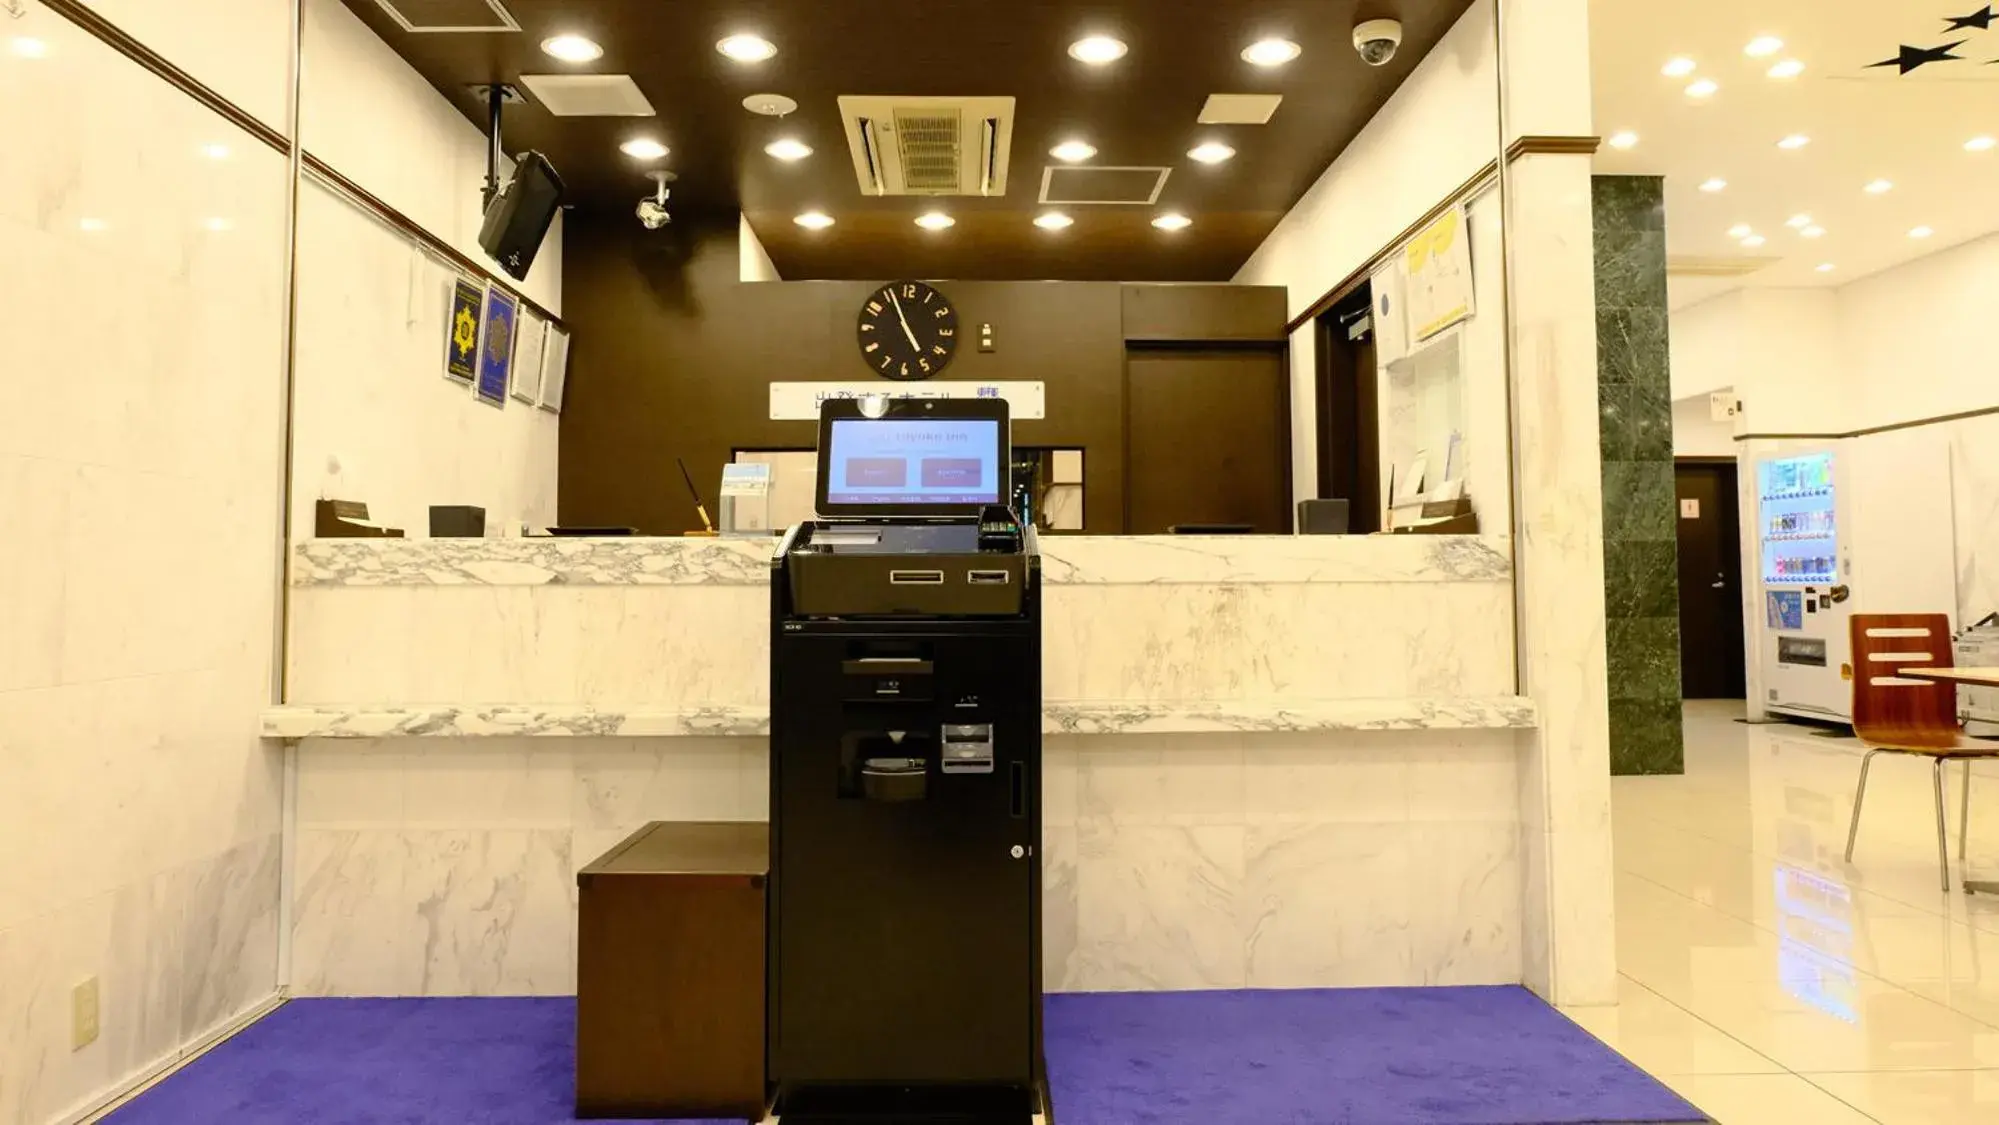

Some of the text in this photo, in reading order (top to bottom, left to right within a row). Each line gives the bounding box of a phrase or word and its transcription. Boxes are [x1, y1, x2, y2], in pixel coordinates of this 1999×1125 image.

[903, 284, 916, 298] 12
[924, 291, 933, 303] 1
[866, 301, 883, 317] 10
[935, 307, 949, 318] 2
[861, 323, 875, 331] 9
[939, 328, 953, 337] 3
[932, 345, 947, 355] 4
[881, 355, 892, 369] 7
[919, 358, 930, 372] 5
[901, 362, 909, 376] 6
